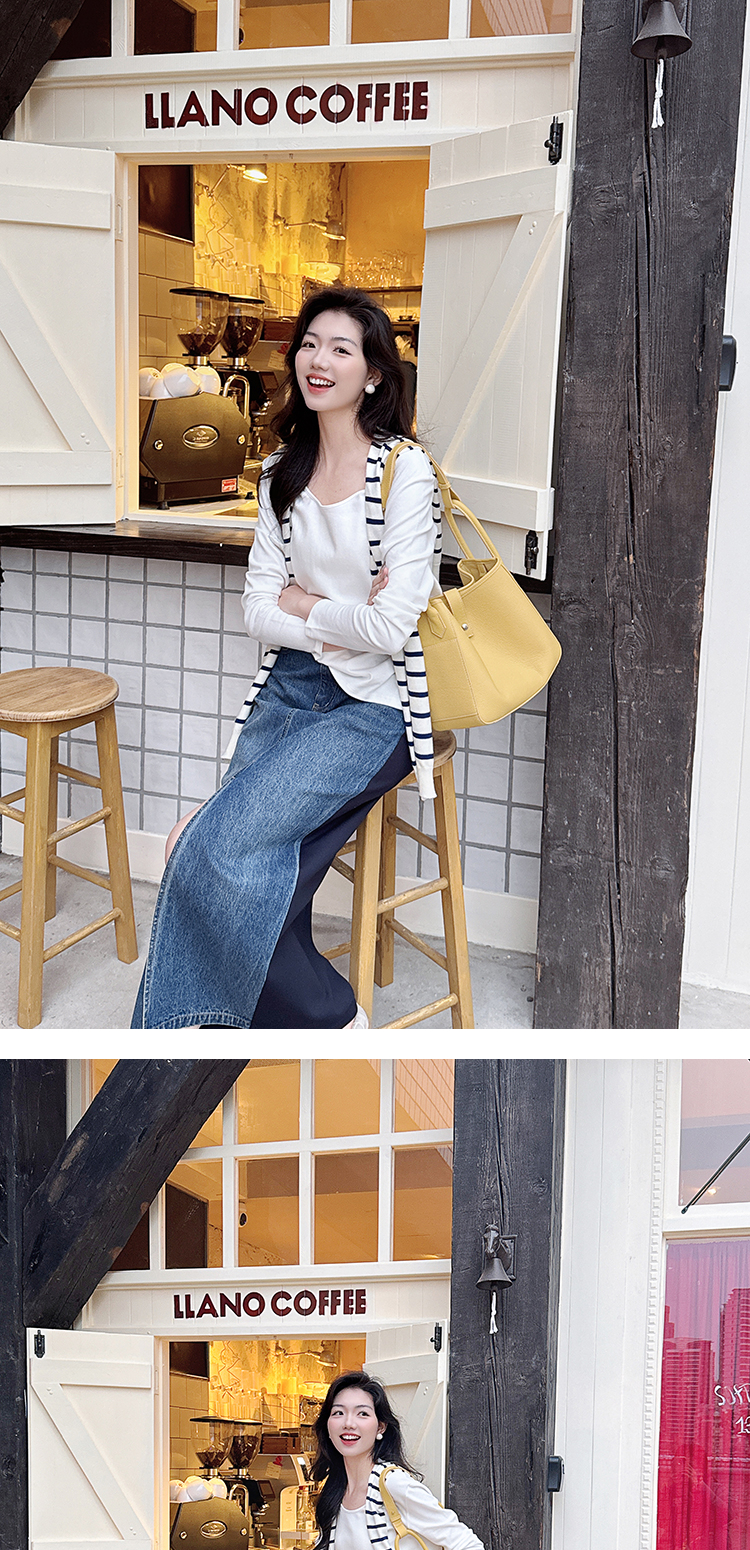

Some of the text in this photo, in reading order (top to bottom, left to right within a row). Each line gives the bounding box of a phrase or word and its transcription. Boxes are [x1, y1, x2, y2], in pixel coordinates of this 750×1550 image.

[145, 81, 429, 129] LLANO COFFEE
[173, 1288, 367, 1319] LLANO COFFEE
